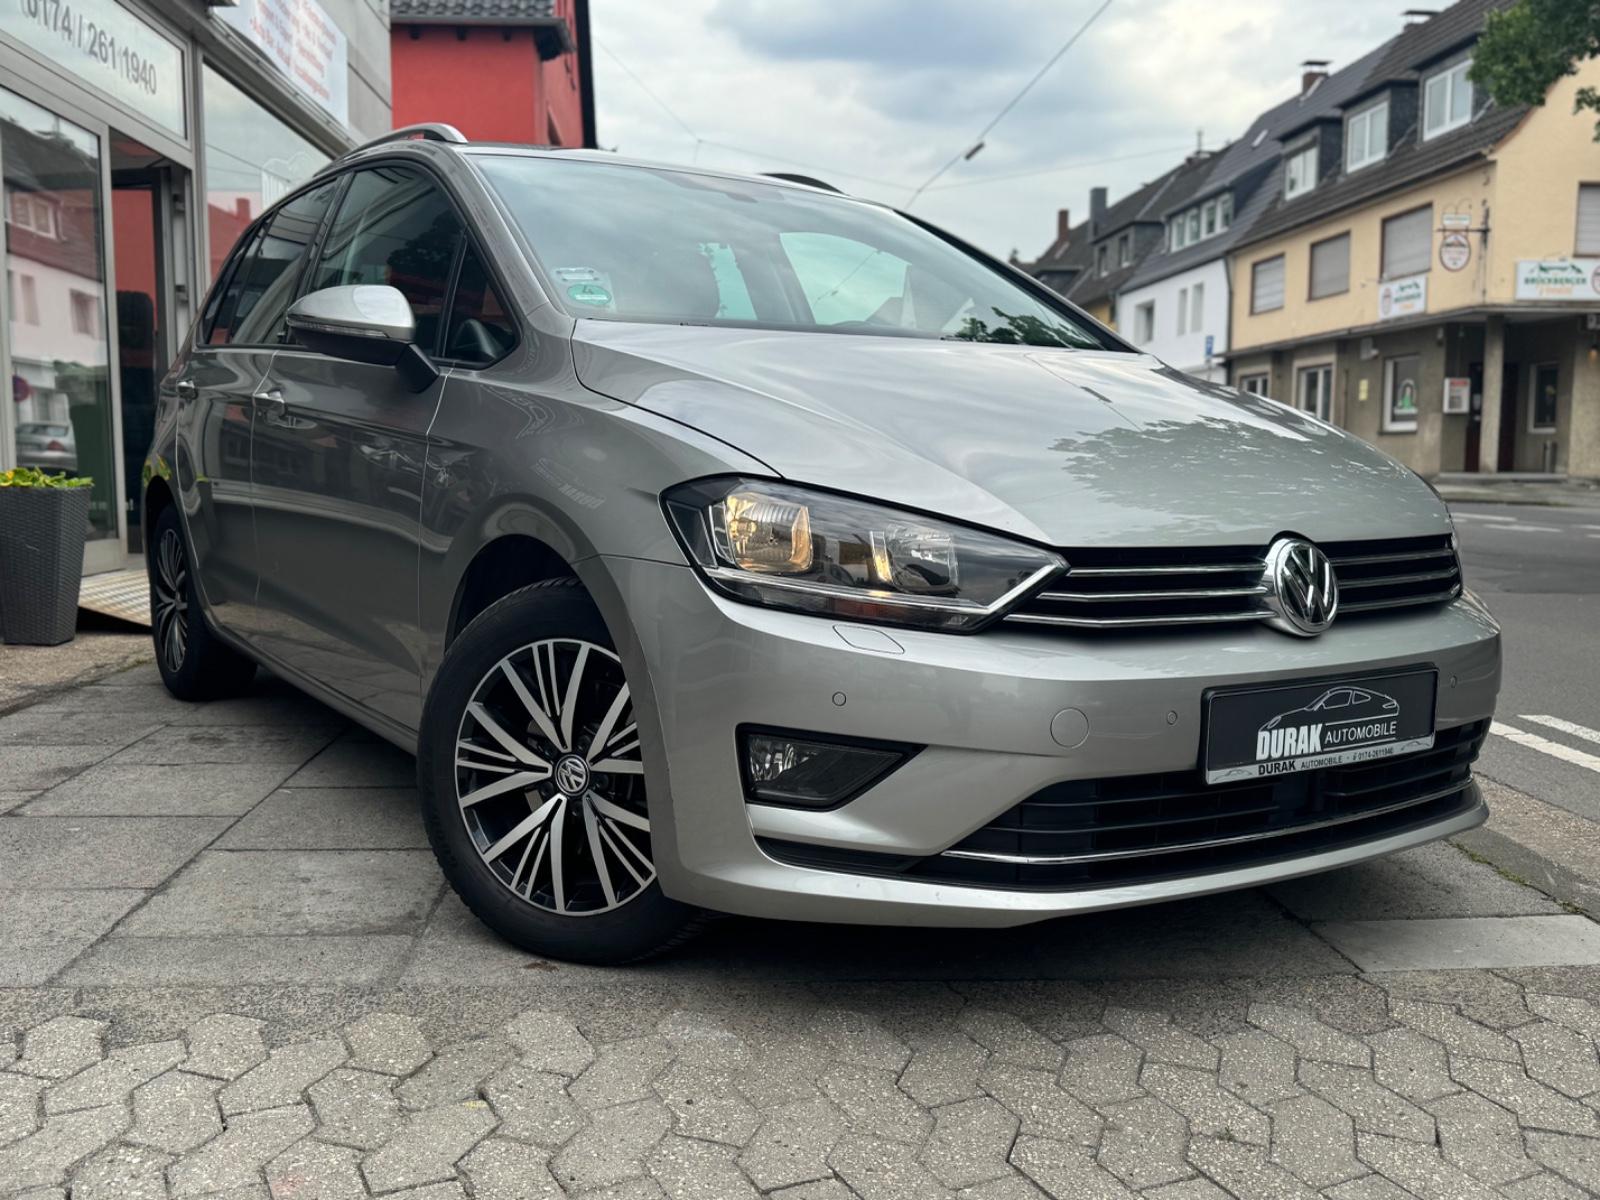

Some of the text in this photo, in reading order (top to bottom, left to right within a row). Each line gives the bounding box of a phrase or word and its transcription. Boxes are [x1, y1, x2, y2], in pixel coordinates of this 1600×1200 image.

[88, 22, 116, 69] 261
[123, 47, 157, 95] 1940
[1256, 721, 1397, 760] DURAK AUTOMOBILE
[1258, 760, 1296, 775] DURAK
[1301, 755, 1343, 769] AUTOMOBILE
